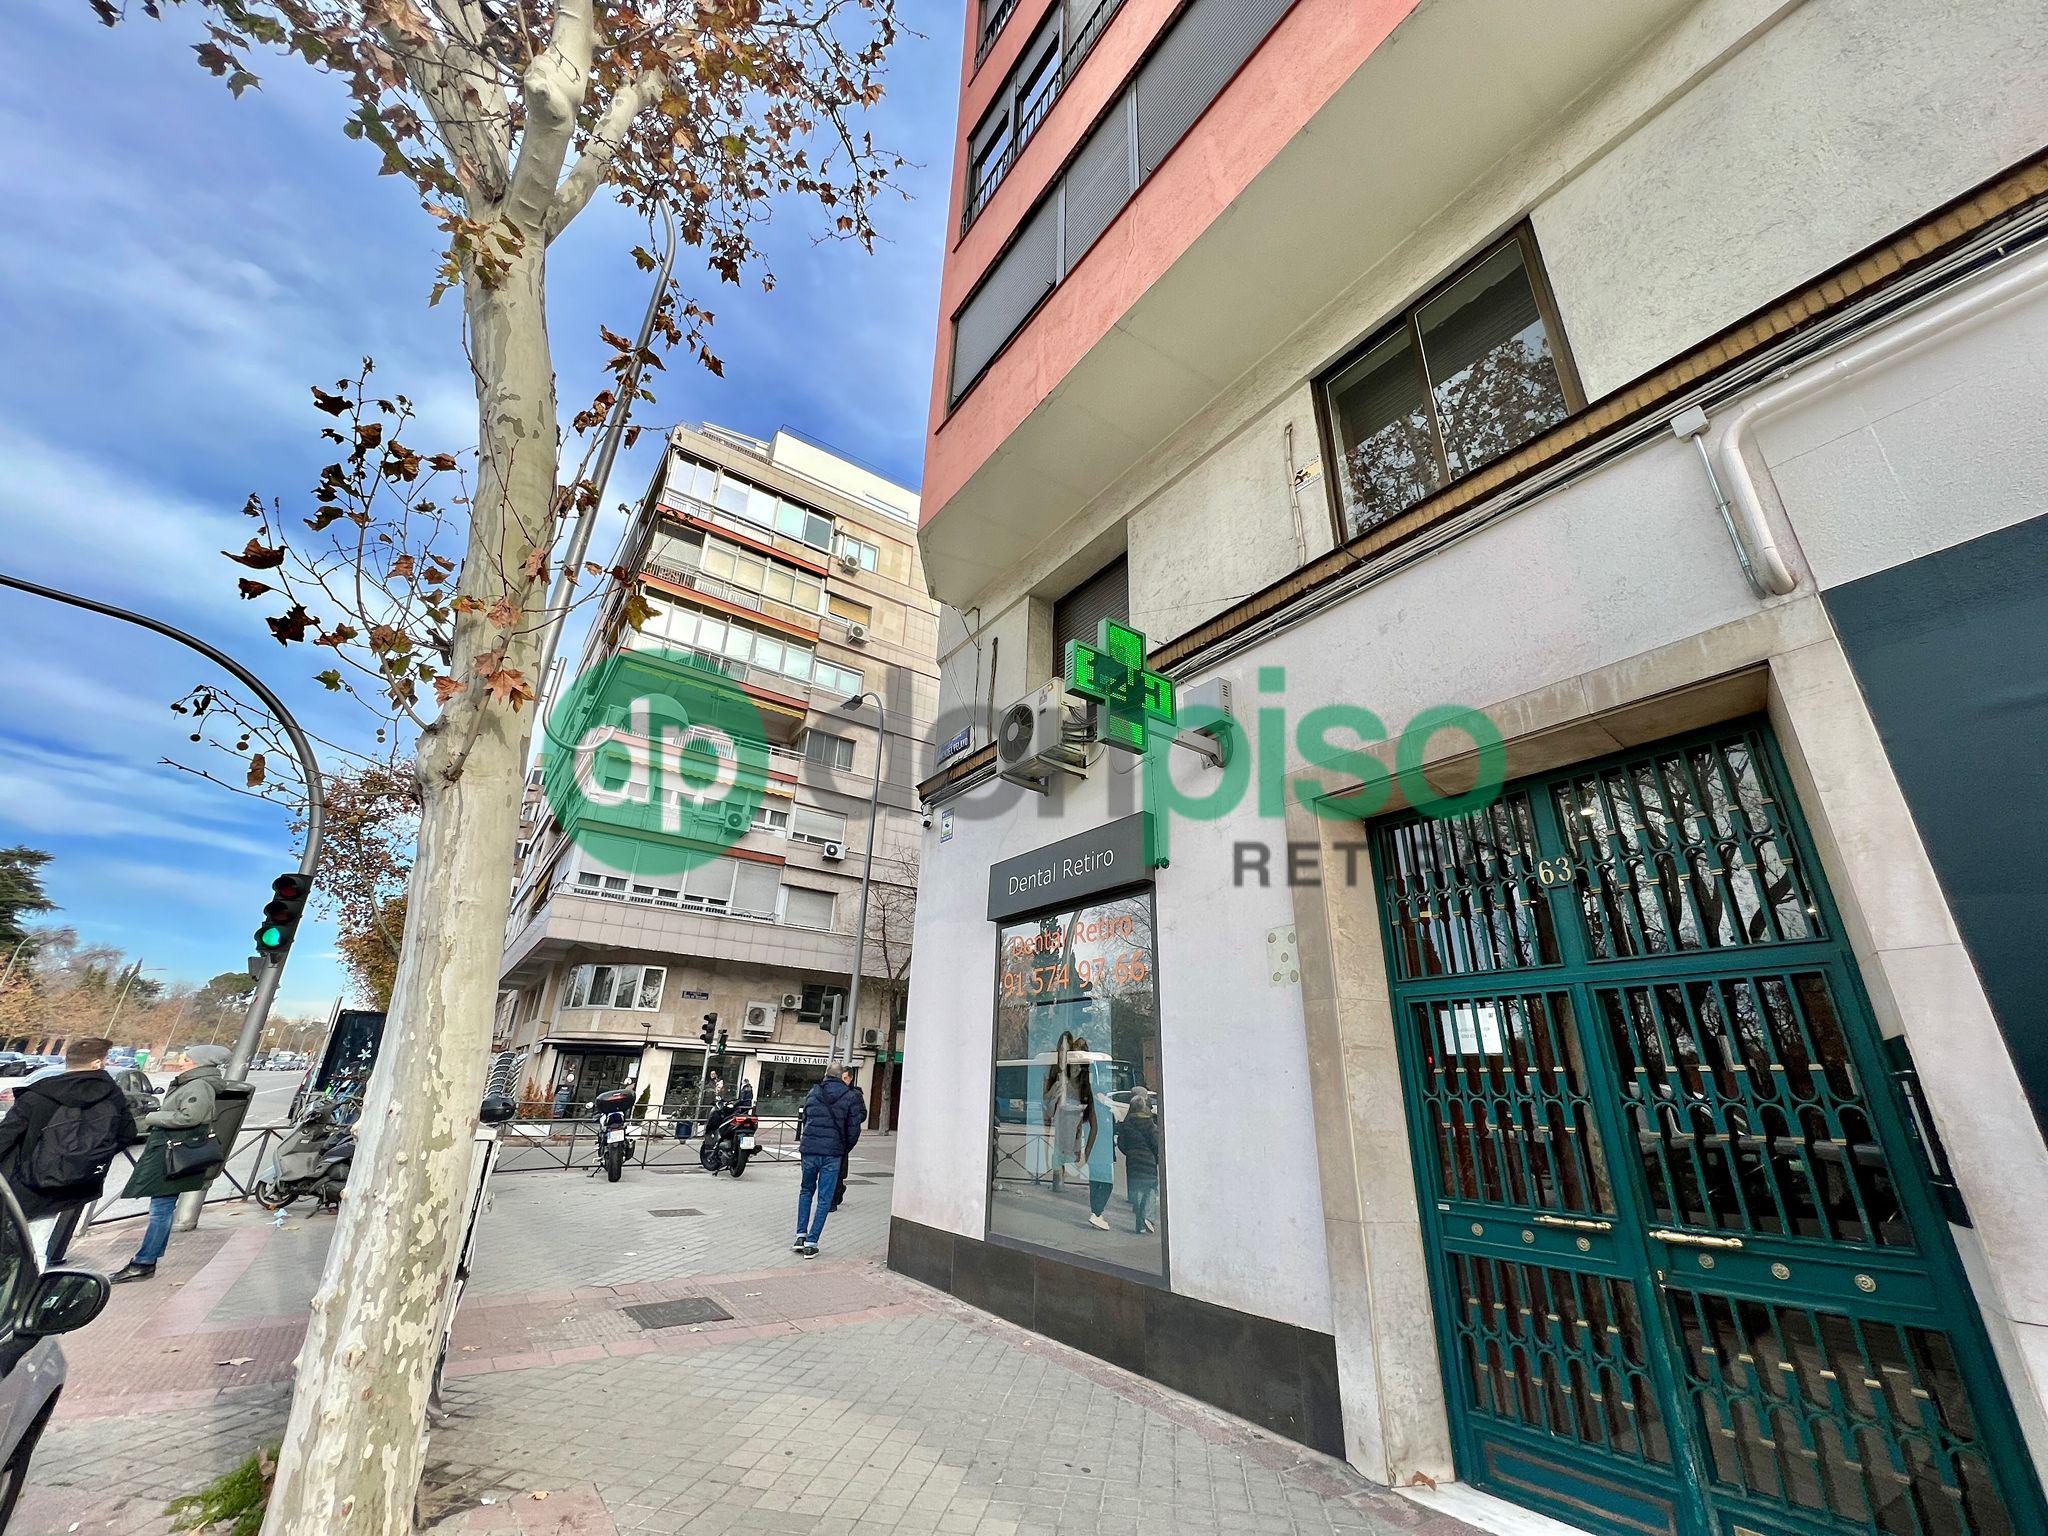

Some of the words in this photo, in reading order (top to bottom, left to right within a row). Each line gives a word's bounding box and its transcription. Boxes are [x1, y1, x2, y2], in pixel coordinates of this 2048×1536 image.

[1008, 862, 1056, 896] Dental
[1062, 849, 1114, 879] Retiro
[1538, 857, 1571, 885] 63
[1010, 923, 1067, 957] Dental
[1074, 914, 1134, 944] Retiro
[1003, 971, 1025, 998] 91
[1032, 963, 1070, 995] 574
[1078, 958, 1106, 988] 97
[1115, 951, 1146, 985] 66
